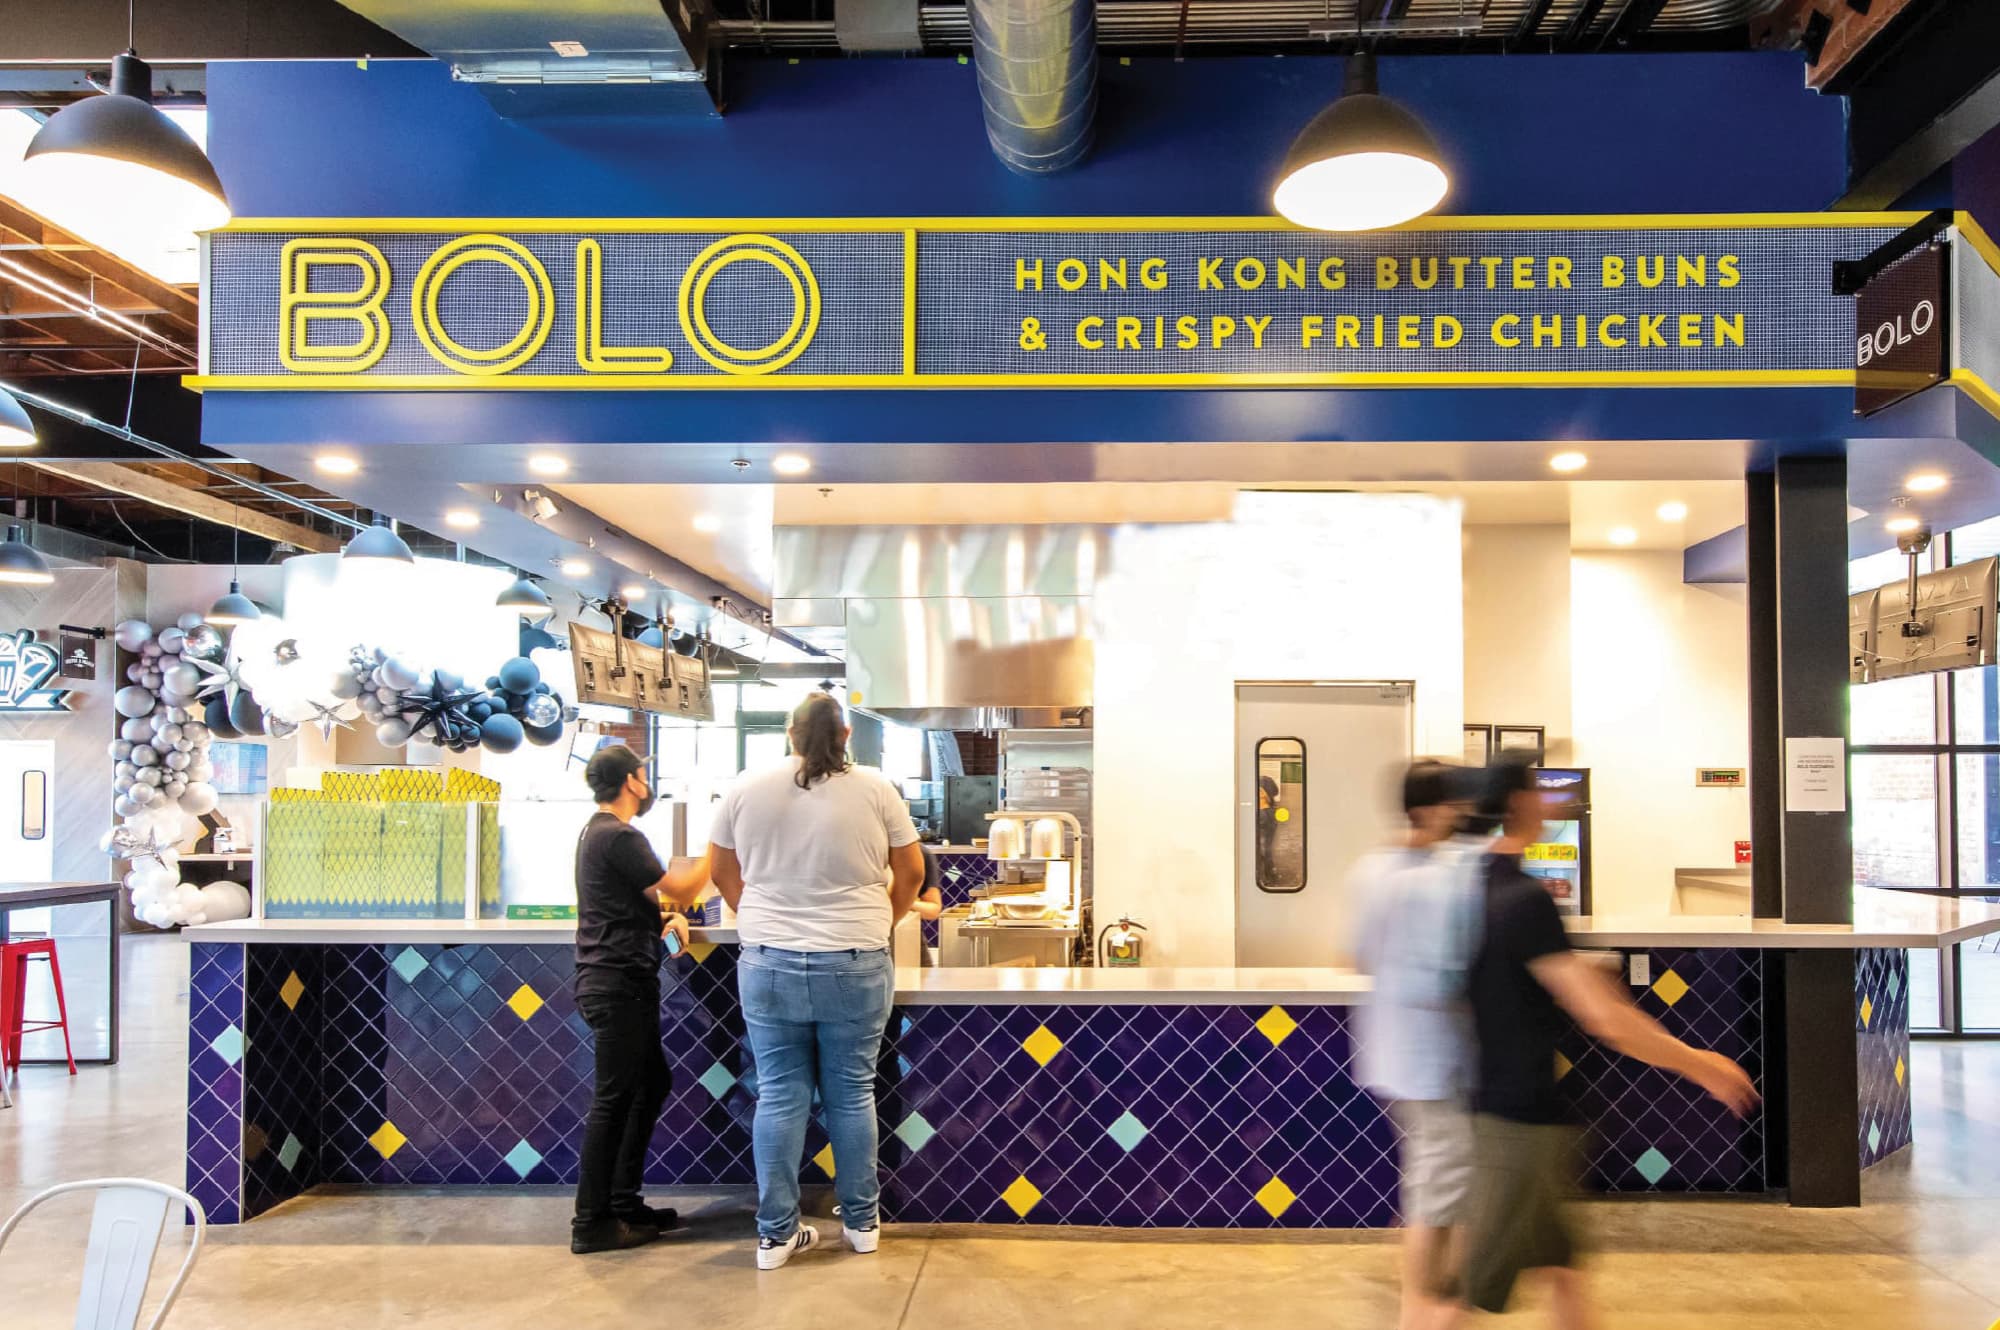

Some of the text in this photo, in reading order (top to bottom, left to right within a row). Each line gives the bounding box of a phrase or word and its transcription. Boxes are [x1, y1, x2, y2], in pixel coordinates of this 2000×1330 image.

[1016, 255, 1741, 292] HONG KONG BUTTER BUNS
[279, 233, 821, 375] BOLO
[1019, 313, 1745, 352] & CRISPY FRIED CHICKEN
[1857, 300, 1933, 366] BOLO
